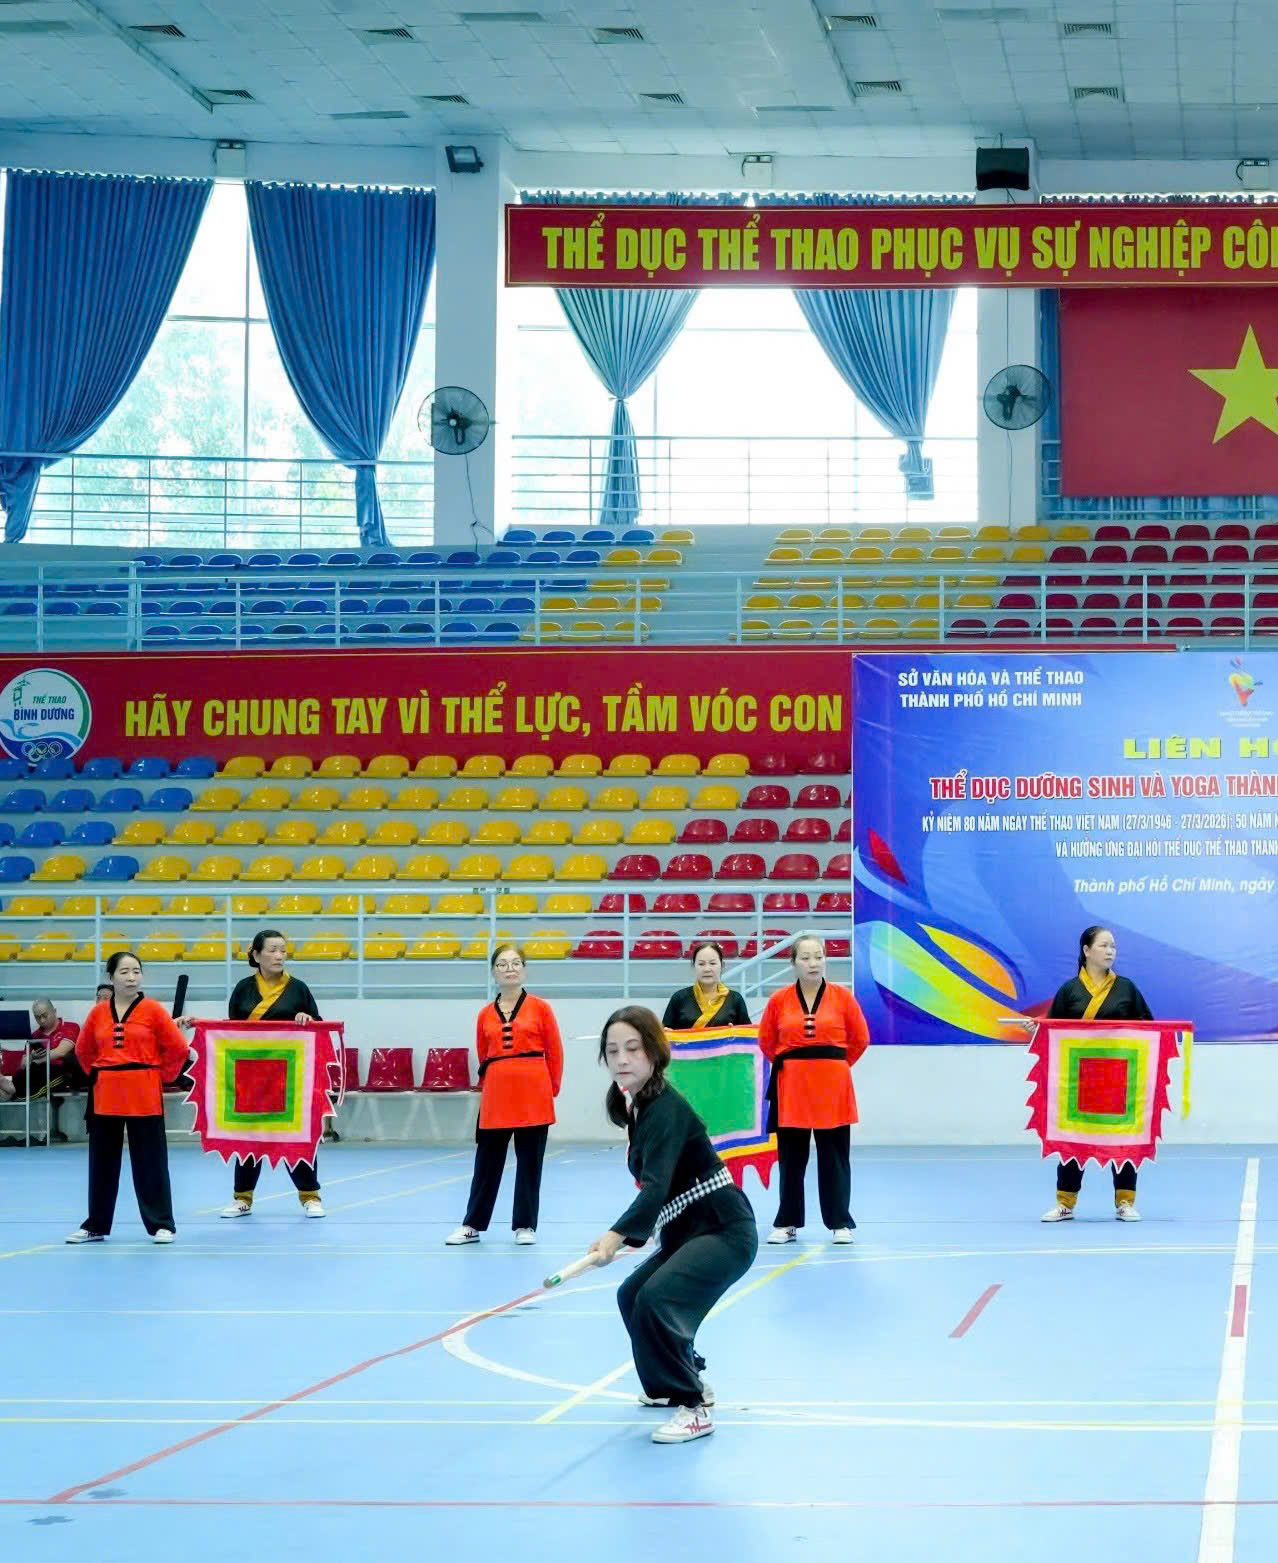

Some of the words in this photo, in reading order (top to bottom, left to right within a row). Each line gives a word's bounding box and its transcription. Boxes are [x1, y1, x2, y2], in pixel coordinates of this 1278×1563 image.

[543, 213, 605, 270] THỂ
[616, 228, 686, 278] DỤC
[698, 212, 761, 270] THỂ
[771, 228, 857, 270] THAO
[871, 228, 964, 278] PHỤC
[975, 226, 1021, 278] VỤ
[1032, 220, 1080, 277] SỰ
[1089, 217, 1211, 277] NGHIỆP
[898, 667, 918, 686] SỞ
[922, 669, 952, 686] VĂN
[957, 669, 986, 685] HÓA
[991, 669, 1010, 685] VÀ
[1015, 666, 1042, 685] THỂ
[1046, 671, 1083, 684] THAO
[900, 691, 949, 708] THÀNH
[954, 689, 983, 707] PHỐ
[988, 690, 1007, 706] HỒ
[1013, 691, 1038, 706] CHÍ
[1042, 693, 1081, 706] MINH
[14, 707, 37, 720] BÌNH
[41, 707, 74, 720] DƯƠNG
[126, 690, 190, 737] HÃY
[203, 697, 320, 736] CHUNG
[333, 696, 385, 734] TAY
[398, 689, 430, 734] VÌ
[443, 681, 506, 734] THỂ
[516, 693, 590, 741] LỰC,
[603, 681, 677, 733] TẦM
[690, 686, 756, 732] VÓC
[769, 693, 842, 732] CON
[1124, 735, 1221, 759] LIÊN
[930, 769, 968, 799] THỂ
[971, 778, 1011, 804] DỤC
[1016, 773, 1082, 799] DƯỠNG
[1088, 777, 1134, 798] SINH
[1141, 771, 1163, 797] VÀ
[1171, 775, 1220, 797] YOGA
[1074, 879, 1114, 893] Thành
[1118, 876, 1148, 895] phố
[1150, 875, 1169, 892] Hồ
[1172, 876, 1198, 892] Chí
[1199, 877, 1235, 893] Minh,
[1240, 878, 1275, 894] ngày
